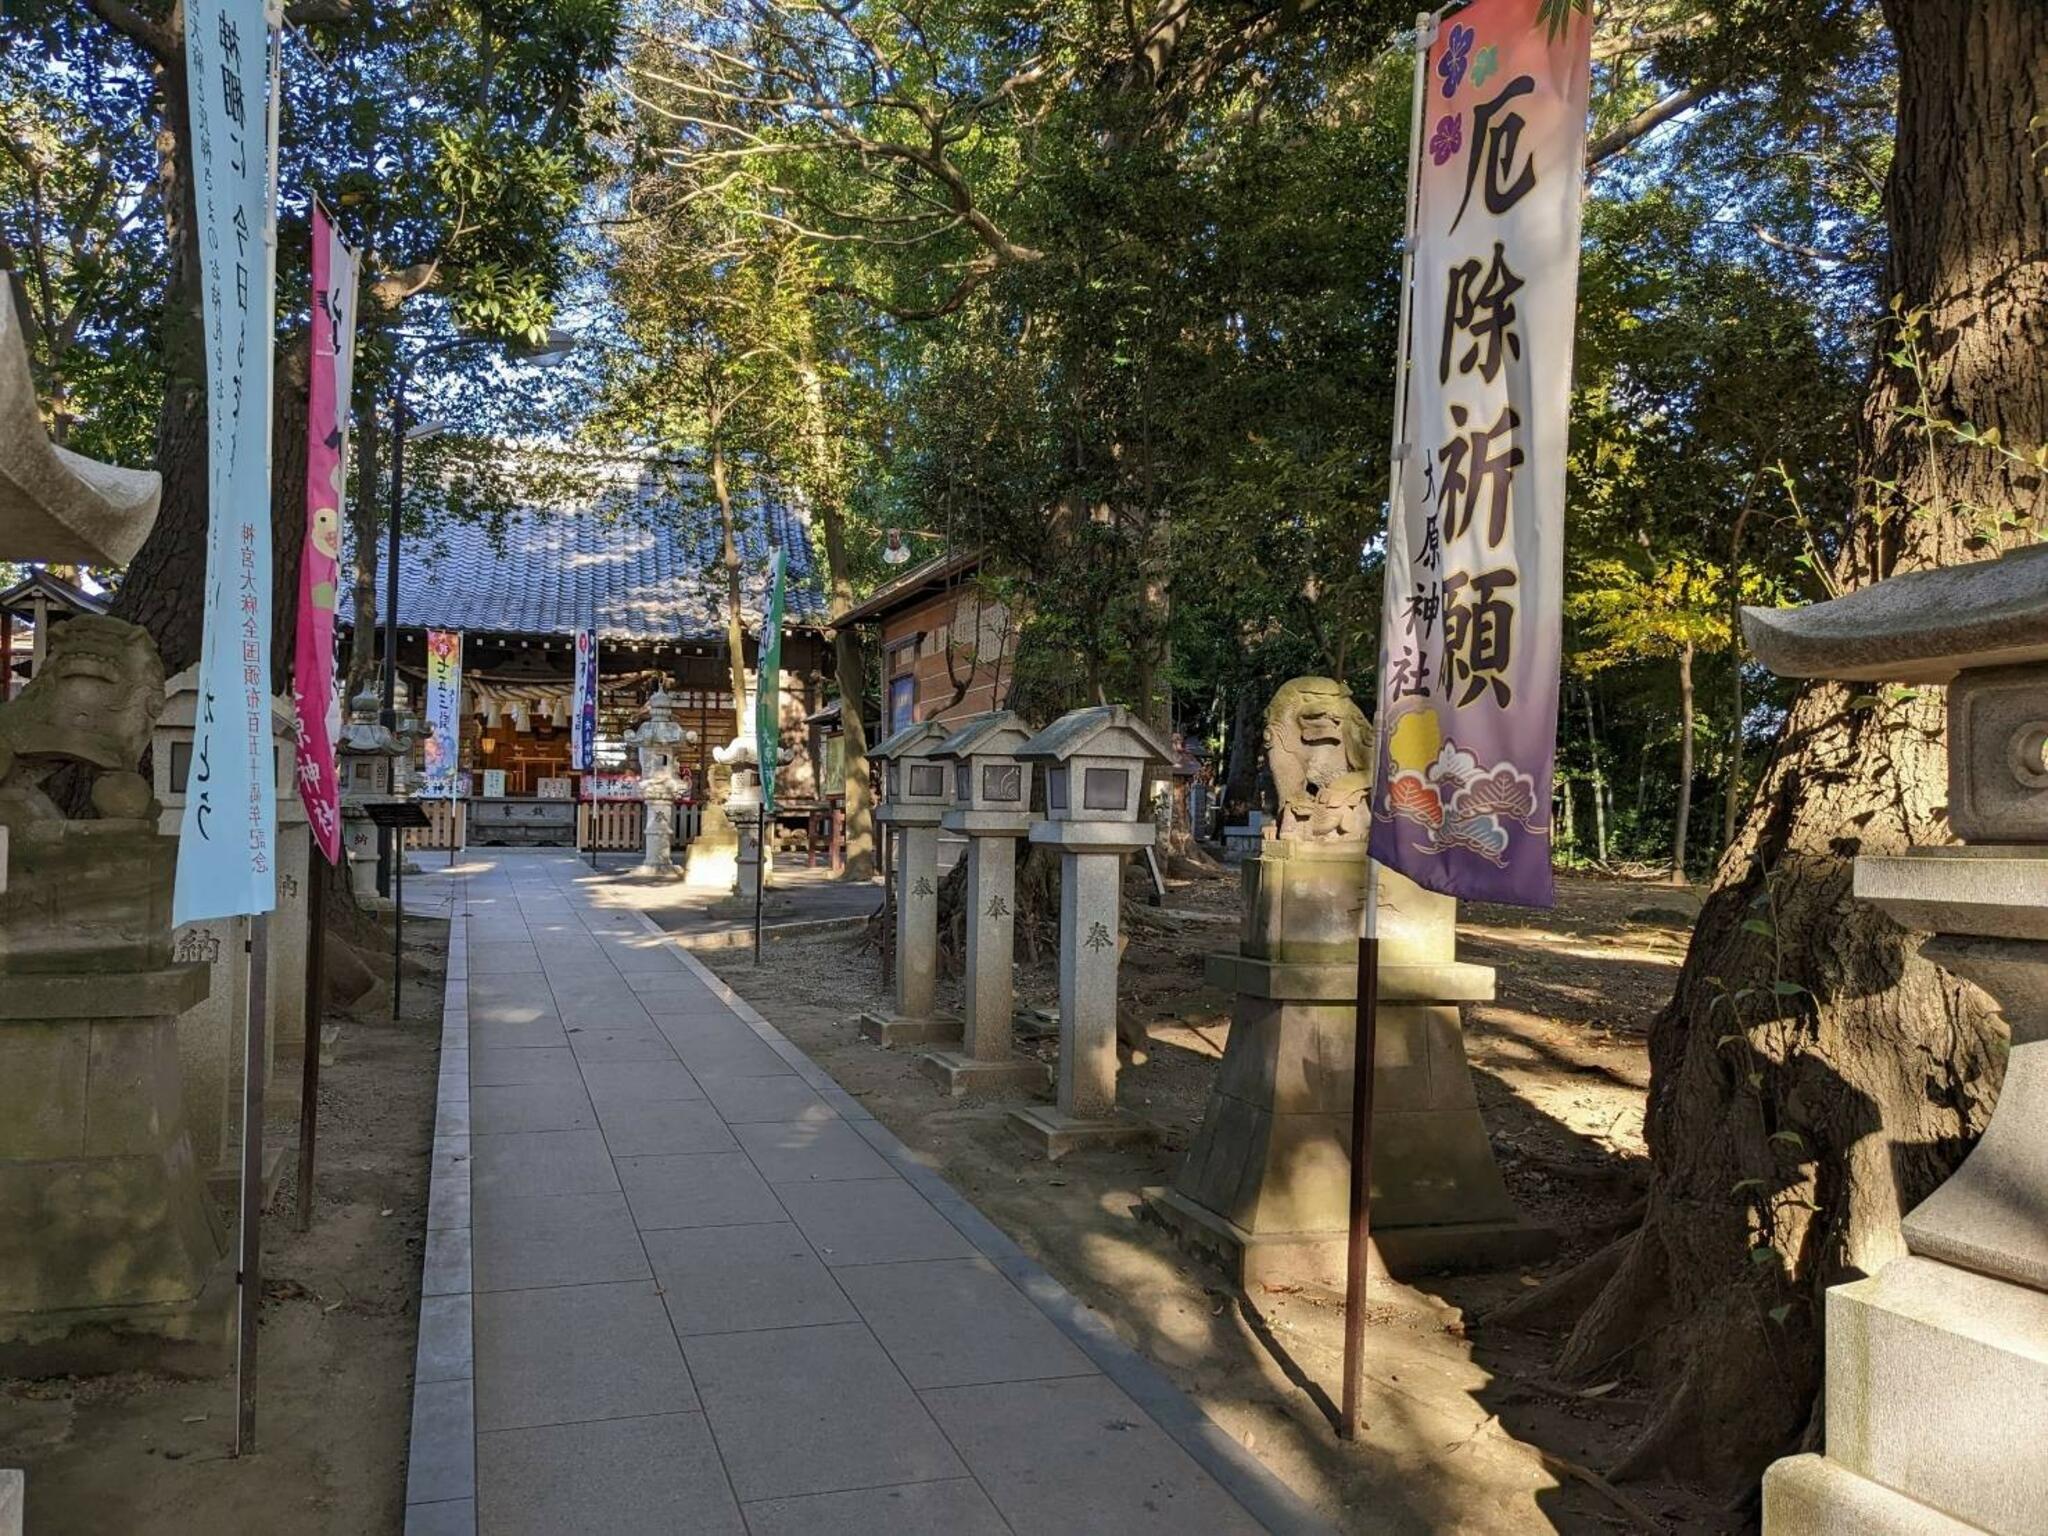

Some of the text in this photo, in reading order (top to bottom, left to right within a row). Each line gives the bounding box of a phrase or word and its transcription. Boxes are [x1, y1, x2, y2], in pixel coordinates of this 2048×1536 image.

[1436, 75, 1536, 711] 厄除祈願
[1388, 448, 1440, 700] 大原神社
[911, 876, 934, 898] 奉
[985, 894, 1010, 920] 奉
[1083, 920, 1113, 953] 奉
